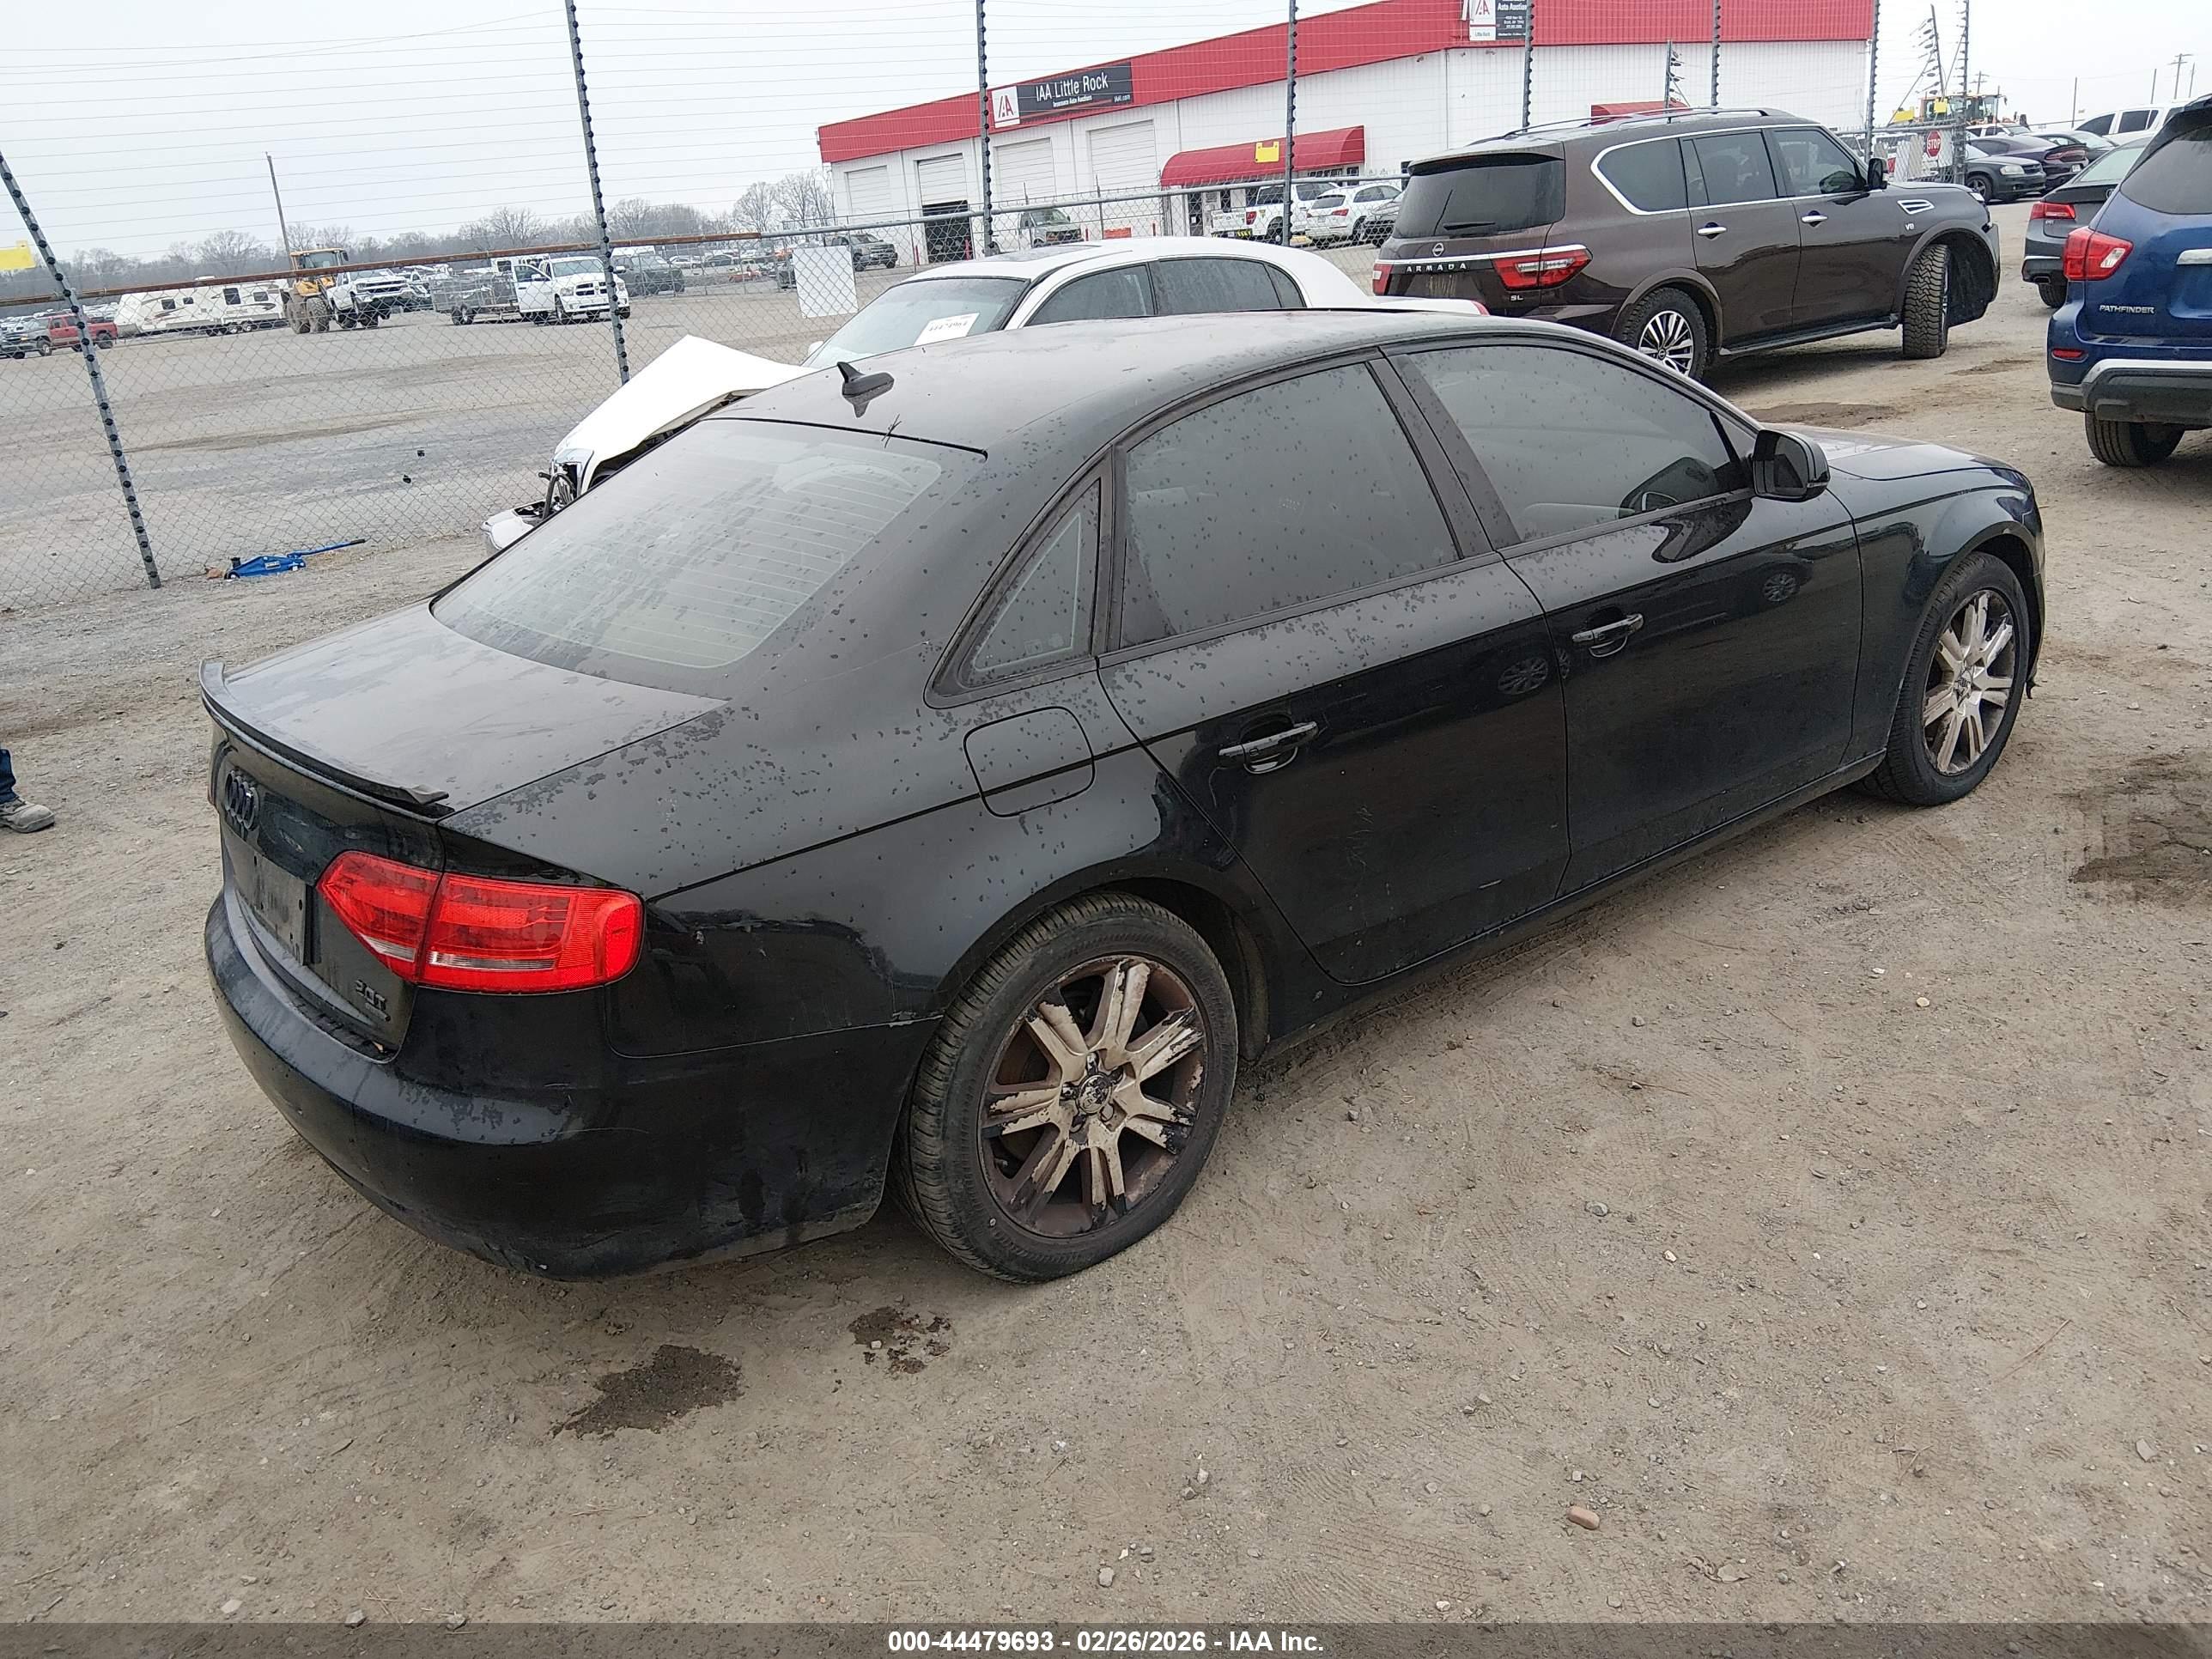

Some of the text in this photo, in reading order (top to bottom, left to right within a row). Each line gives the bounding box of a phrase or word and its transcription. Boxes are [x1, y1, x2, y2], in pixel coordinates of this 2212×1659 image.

[1036, 71, 1109, 102] IAA Little Rock
[1928, 138, 1941, 150] STOP
[1406, 263, 1468, 273] ARMADA
[2099, 304, 2155, 314] PATHFINDER
